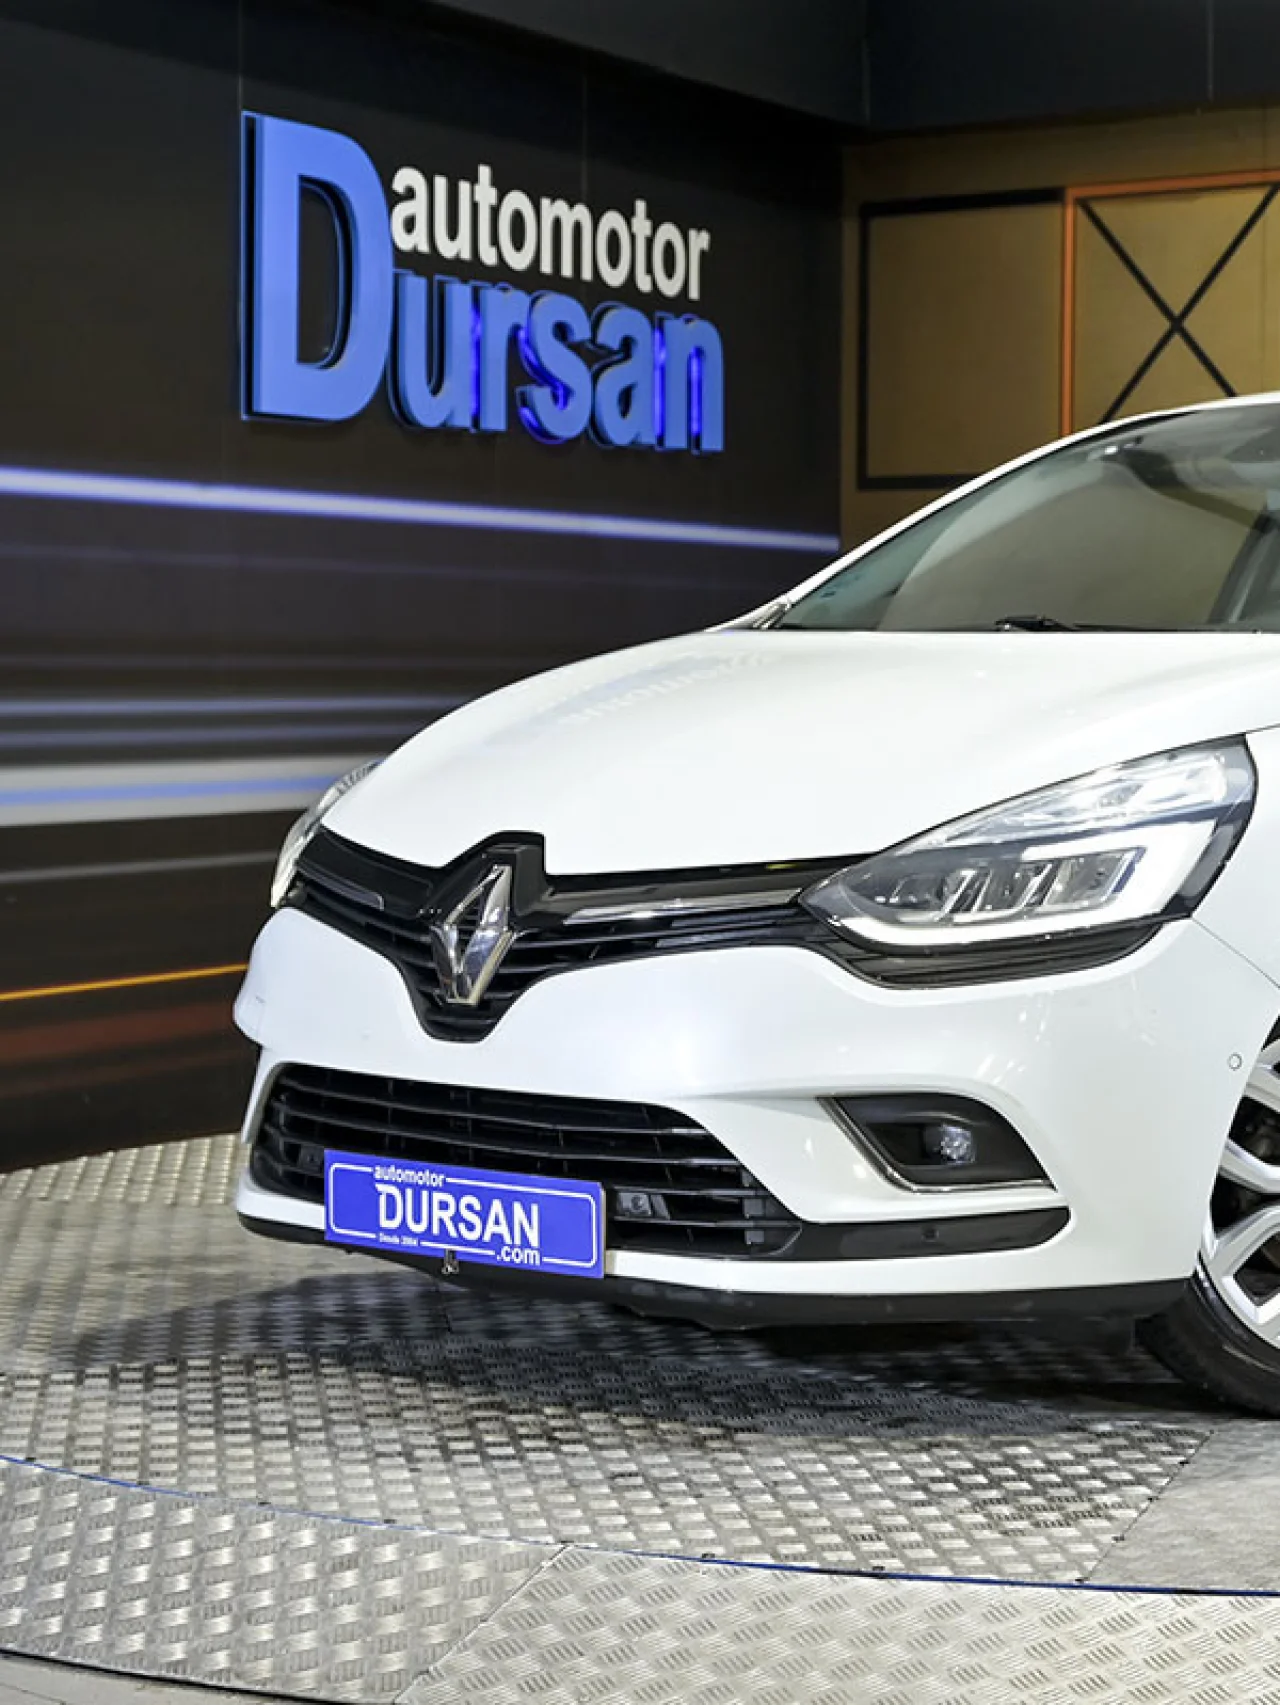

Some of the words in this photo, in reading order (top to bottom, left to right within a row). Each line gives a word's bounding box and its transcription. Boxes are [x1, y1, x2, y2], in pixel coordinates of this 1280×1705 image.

[390, 164, 710, 300] automotor
[241, 110, 724, 454] Dursan
[375, 1164, 445, 1188] automotor
[375, 1183, 540, 1249] DURSAN
[496, 1245, 541, 1267] .com
